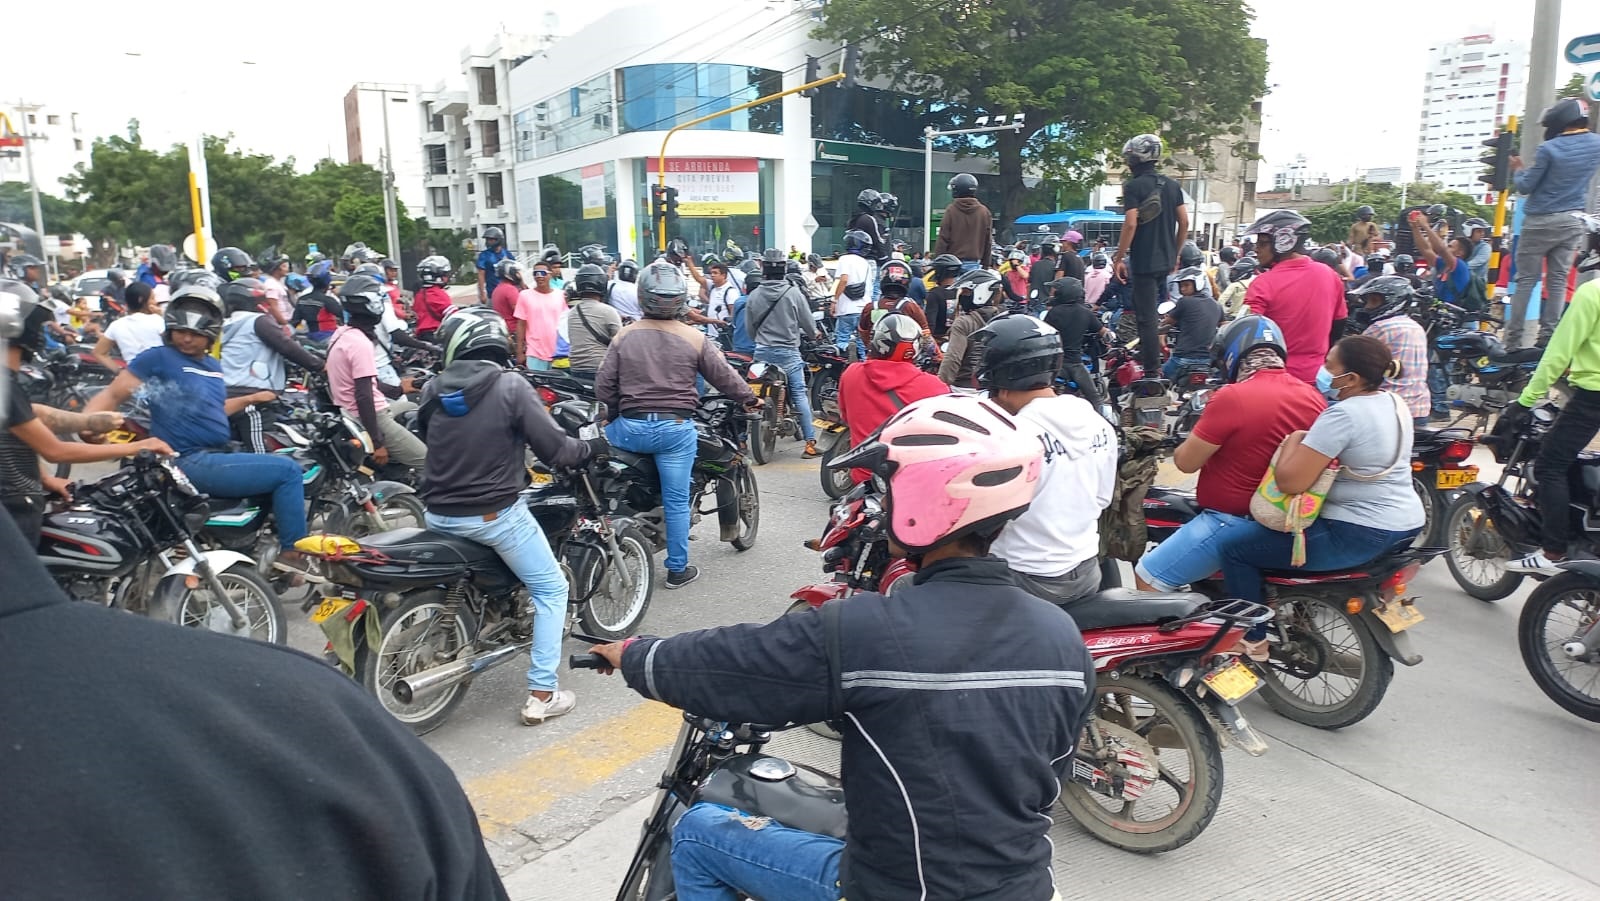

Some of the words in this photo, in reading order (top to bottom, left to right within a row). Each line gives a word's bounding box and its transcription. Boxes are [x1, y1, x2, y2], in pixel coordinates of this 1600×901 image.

[669, 161, 680, 172] SE
[685, 161, 730, 172] ARRIENDA
[677, 174, 695, 183] CITA
[700, 174, 730, 183] PREVIA
